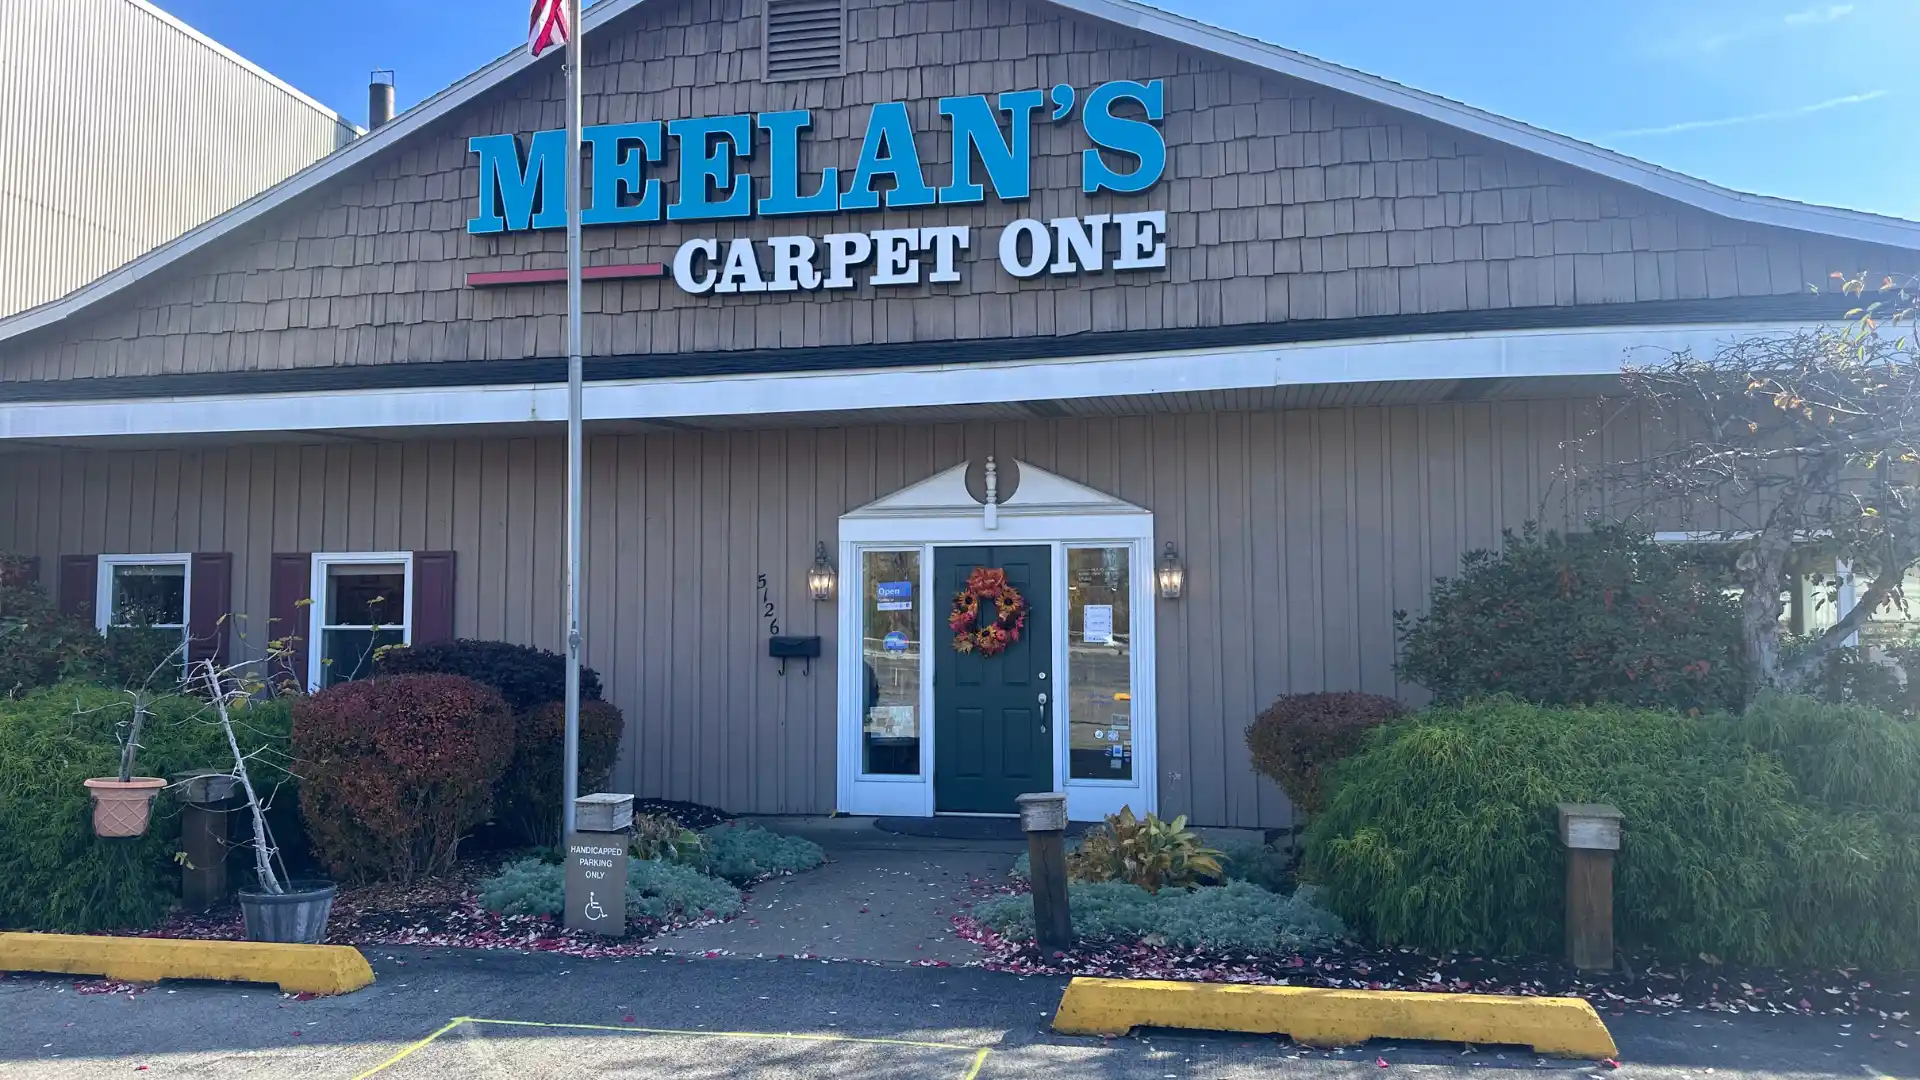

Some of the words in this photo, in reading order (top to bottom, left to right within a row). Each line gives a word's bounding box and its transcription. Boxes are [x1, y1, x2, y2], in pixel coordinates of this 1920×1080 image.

[467, 79, 1166, 235] MEELAN'S
[672, 226, 969, 295] CARPET
[999, 210, 1167, 277] ONE
[878, 587, 900, 596] Open
[757, 573, 779, 635] 5126
[570, 845, 623, 856] HANDICAPPED
[579, 858, 613, 868] PARKING
[585, 870, 605, 879] ONLY
